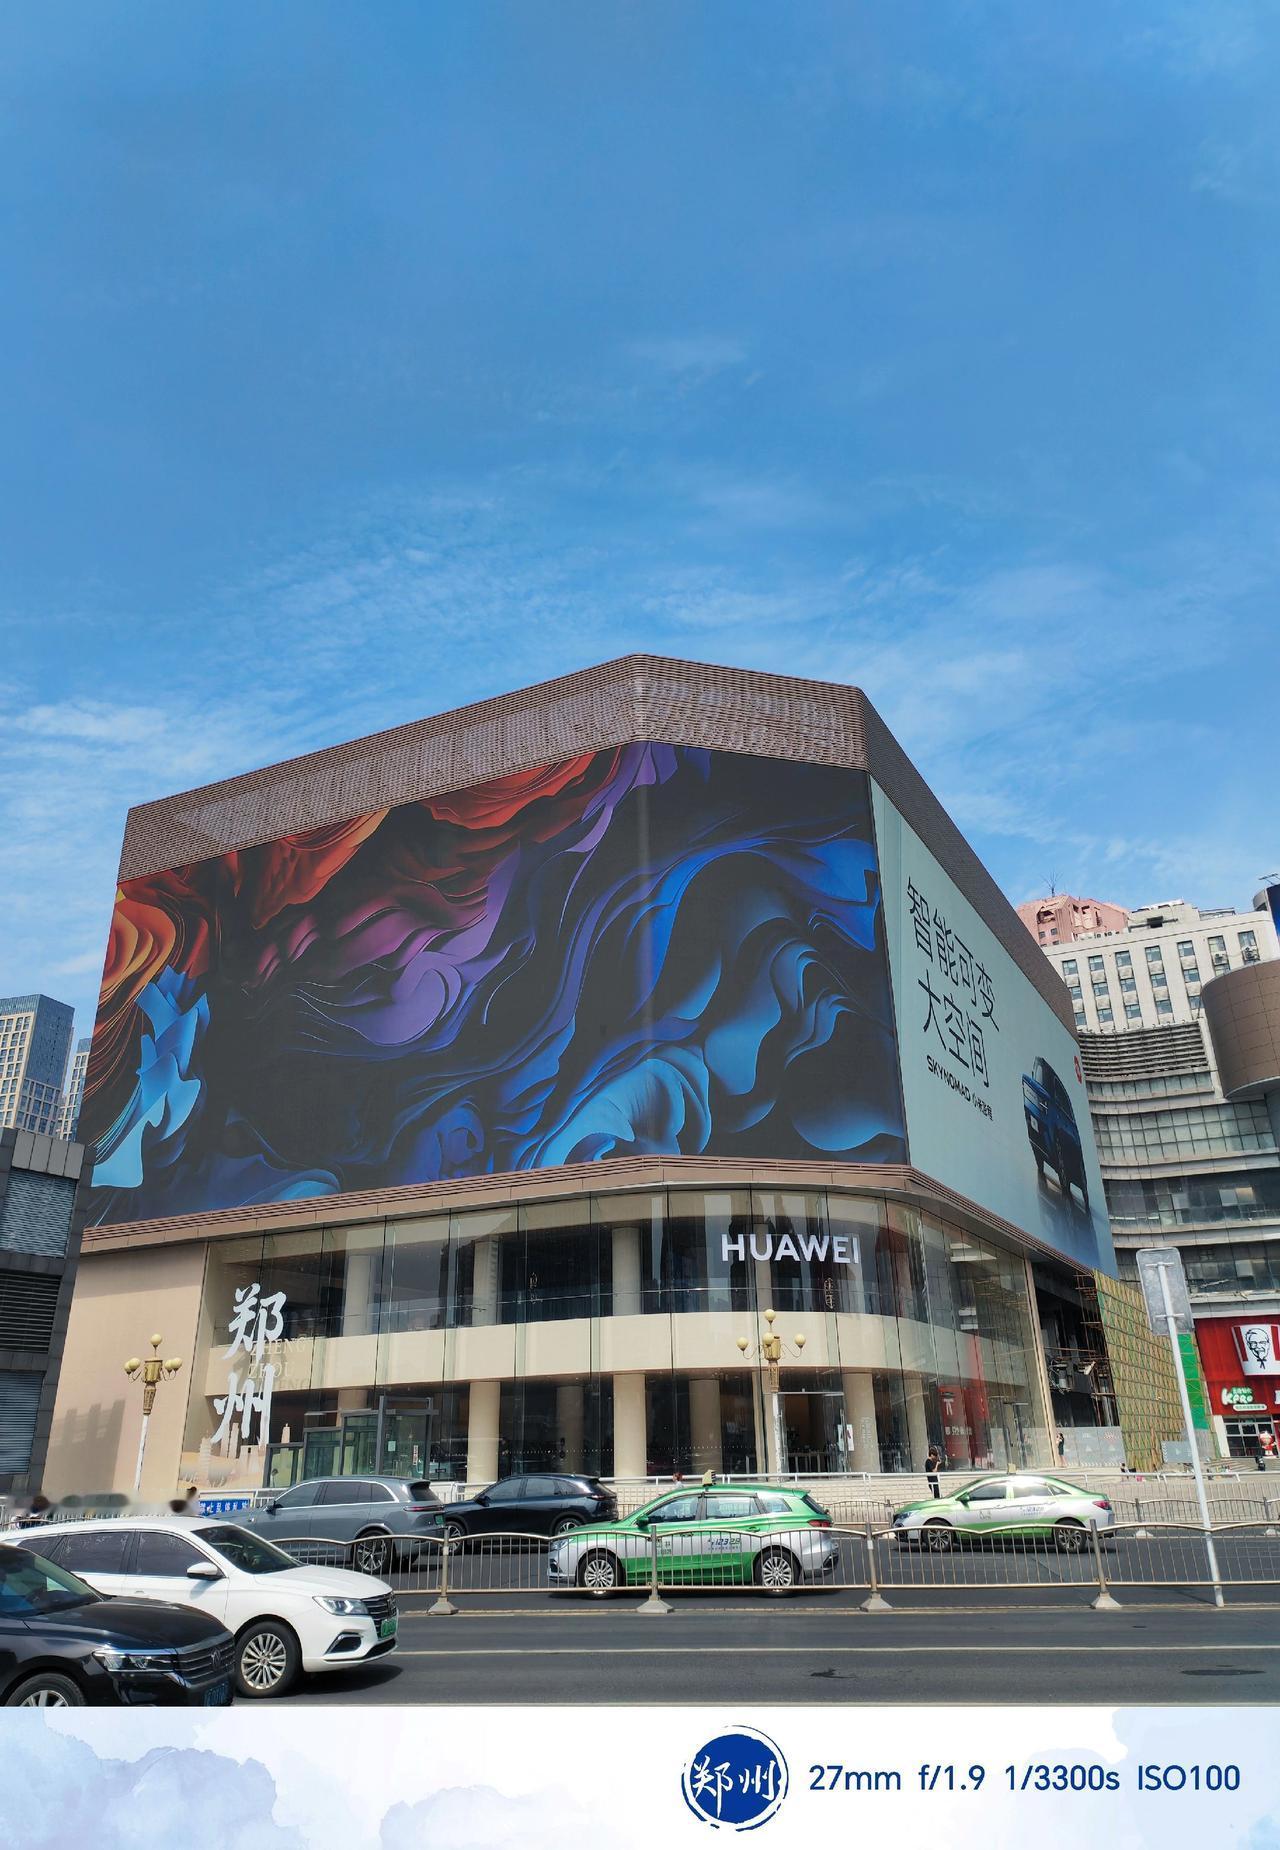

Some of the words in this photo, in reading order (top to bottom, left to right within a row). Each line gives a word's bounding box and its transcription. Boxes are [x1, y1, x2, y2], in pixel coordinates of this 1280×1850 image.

[907, 876, 1000, 1032] 智能可变
[917, 968, 989, 1088] 大空间
[926, 1054, 971, 1102] SKYNOMAD
[721, 1233, 861, 1264] HUAWEI
[210, 1283, 287, 1449] 郑州
